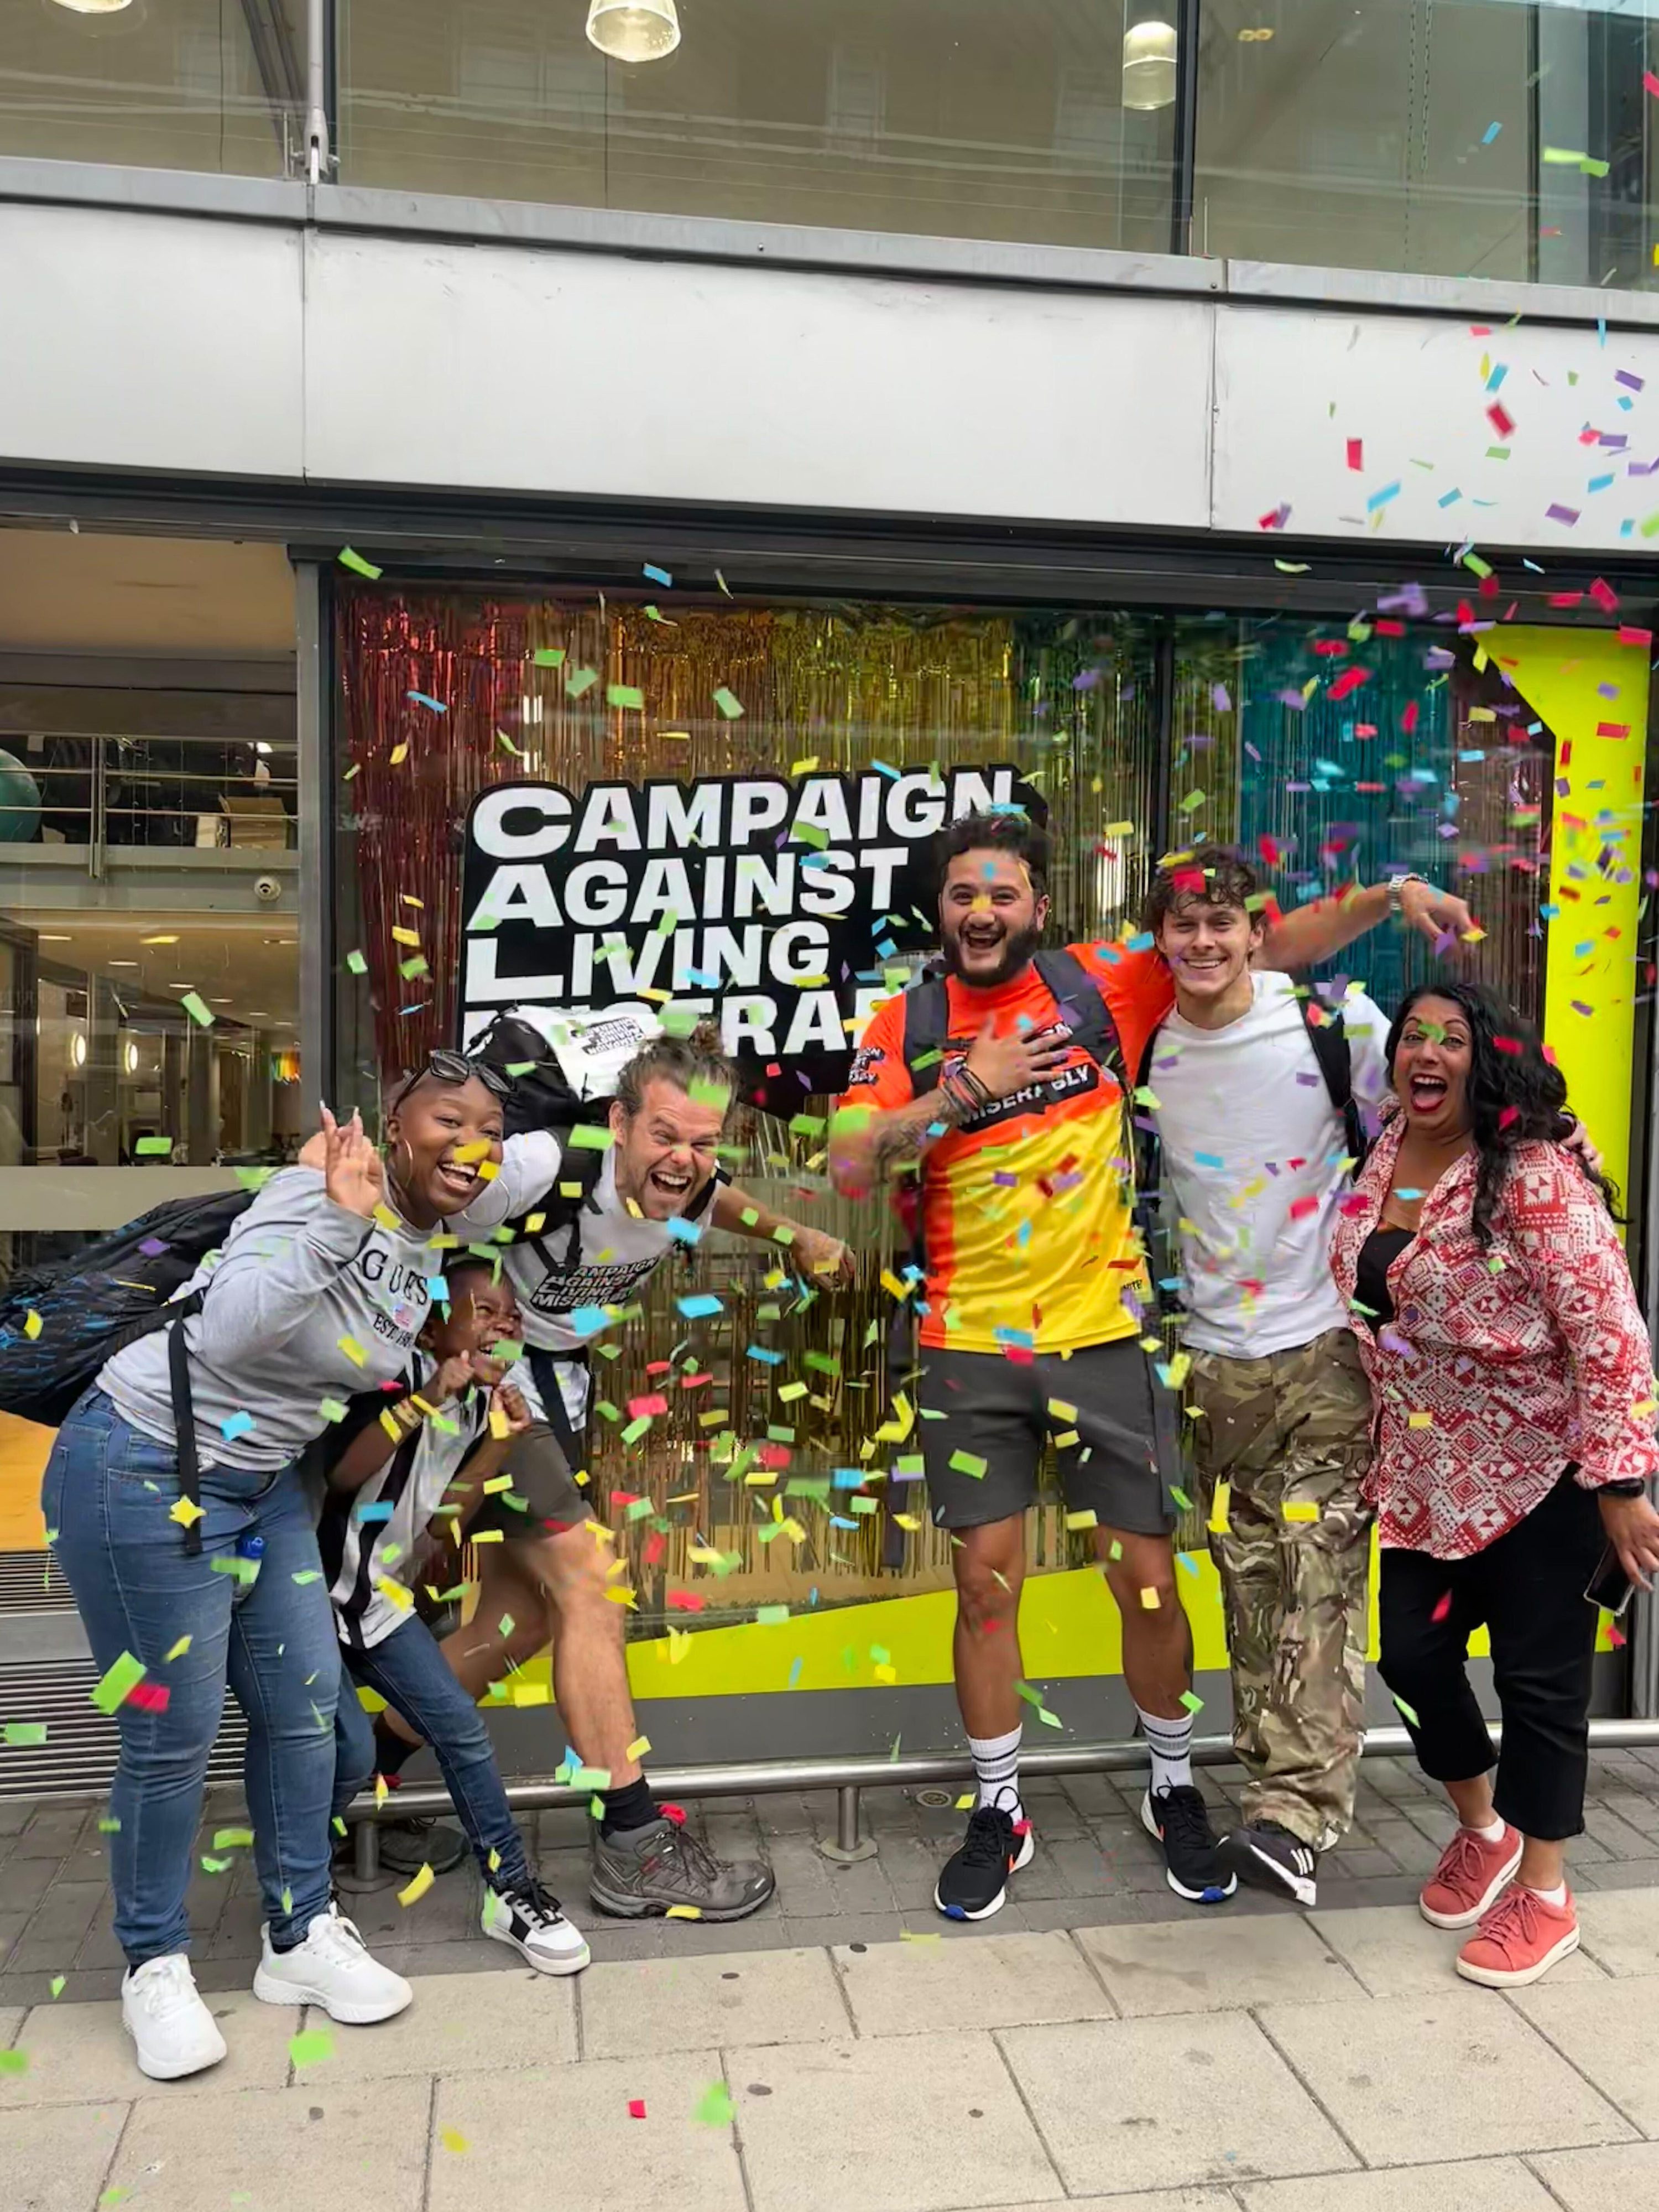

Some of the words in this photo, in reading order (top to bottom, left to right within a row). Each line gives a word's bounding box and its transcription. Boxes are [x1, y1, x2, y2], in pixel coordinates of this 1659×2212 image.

[473, 771, 1012, 858] CAMPAIGN
[466, 847, 909, 931] AGAINST
[466, 920, 830, 1002] LIVING
[573, 1257, 656, 1277] AMPAIGN
